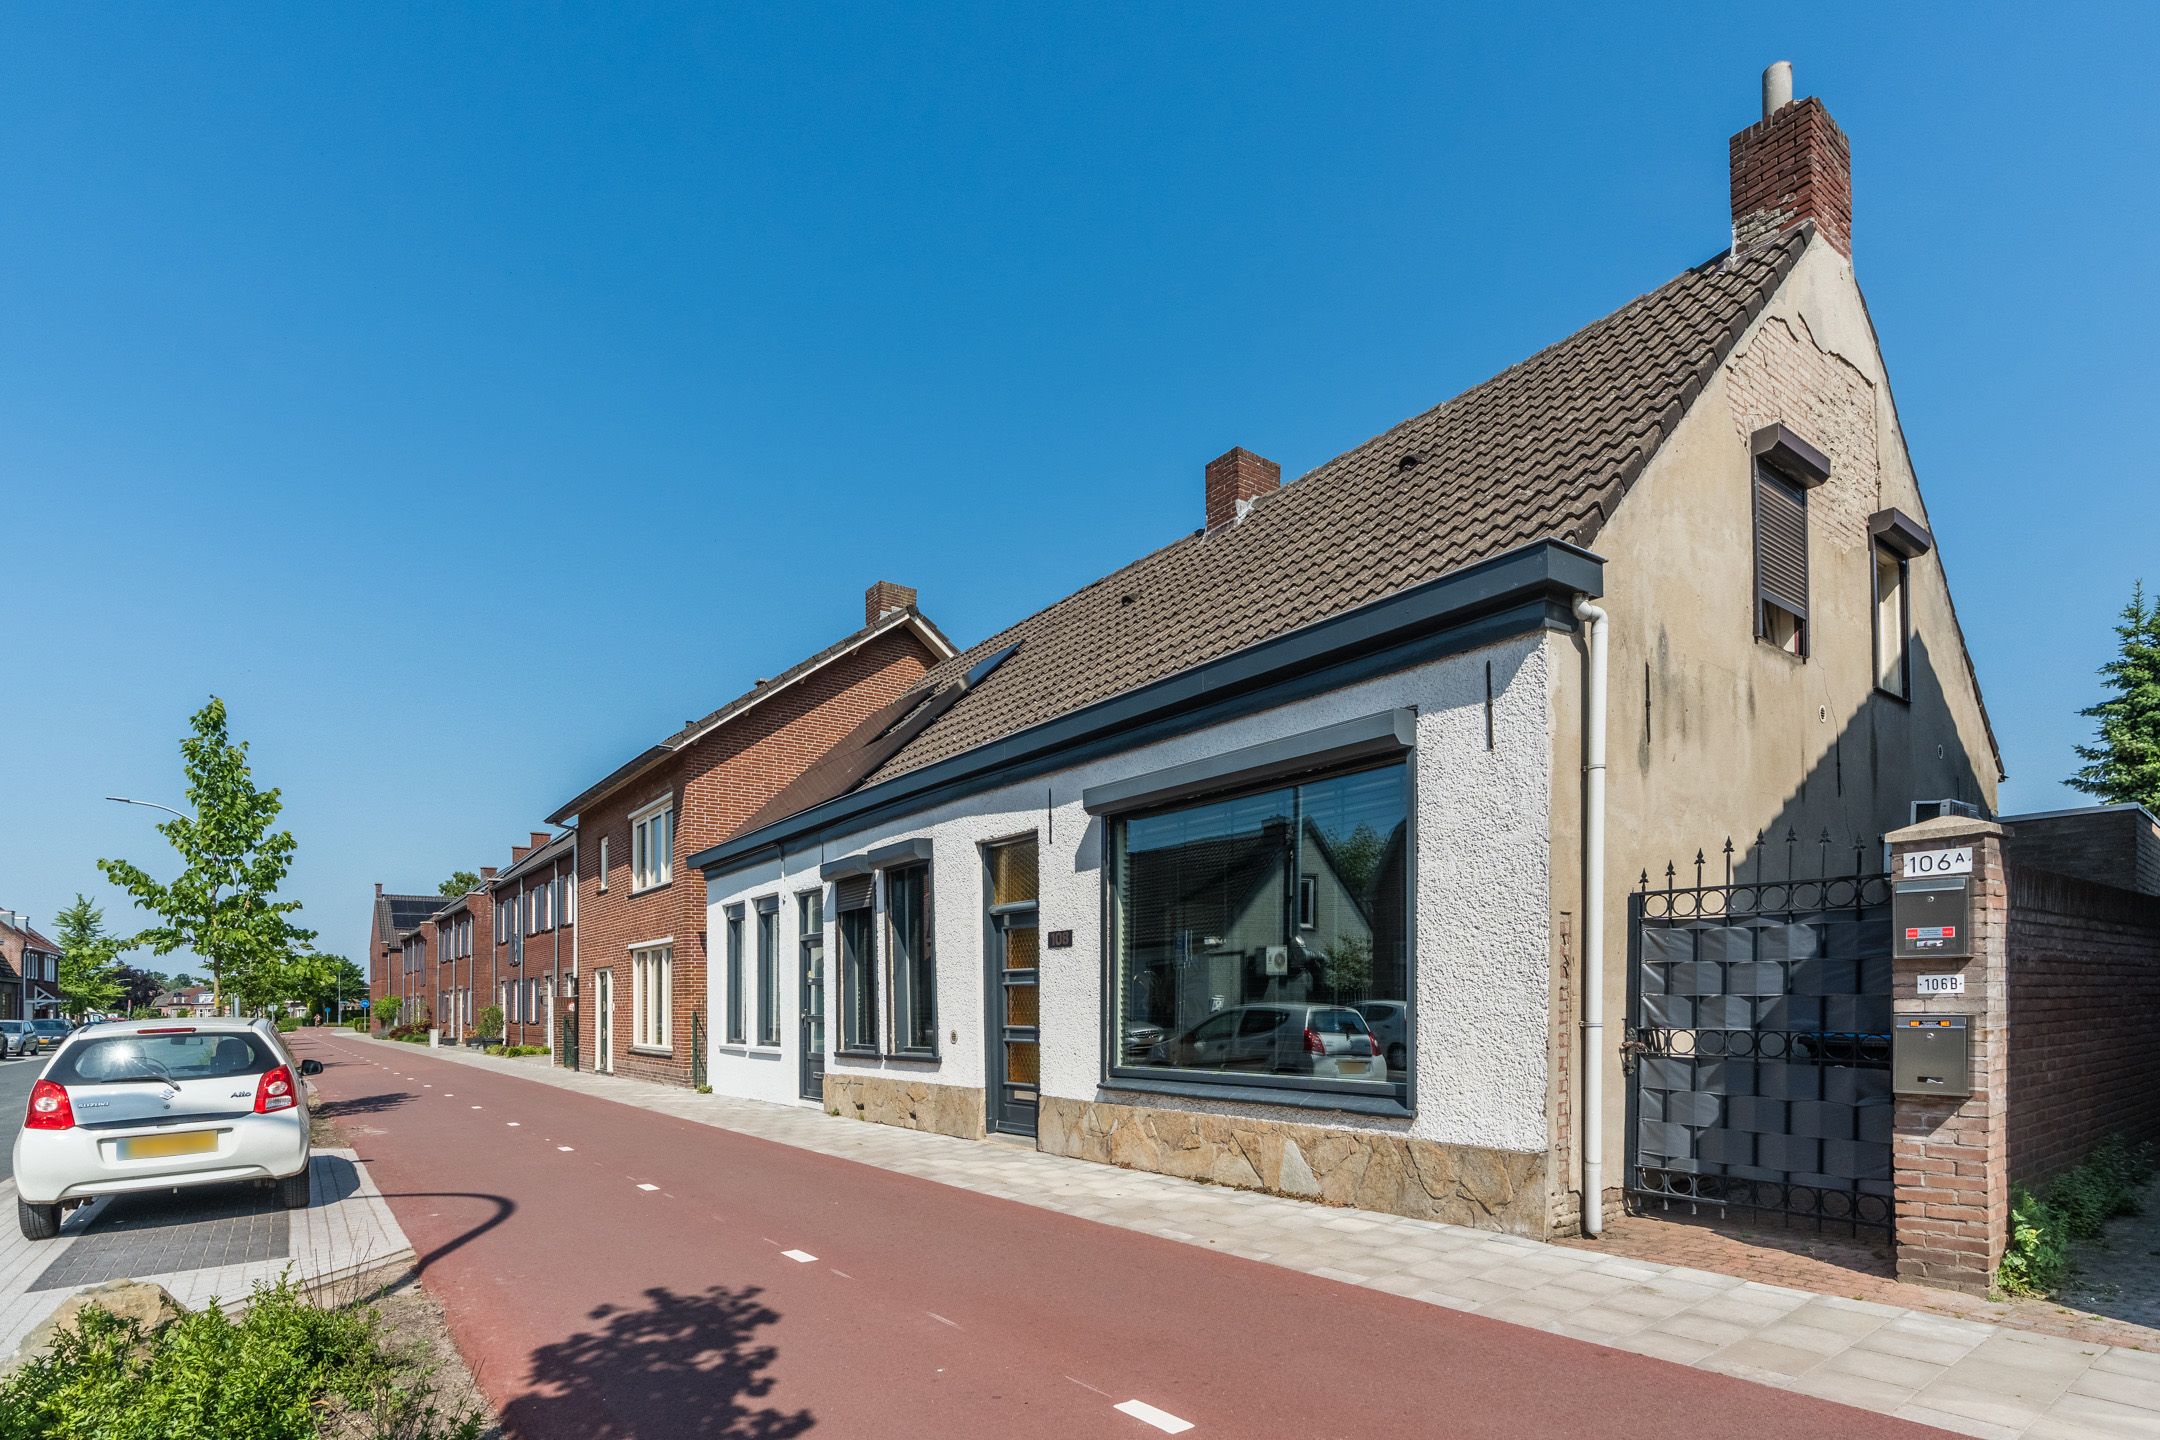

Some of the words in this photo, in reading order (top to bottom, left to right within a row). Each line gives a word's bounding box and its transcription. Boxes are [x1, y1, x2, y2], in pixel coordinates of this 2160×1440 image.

[1910, 852, 1965, 873] 106A
[1051, 931, 1069, 946] 108
[1925, 977, 1958, 991] 106B
